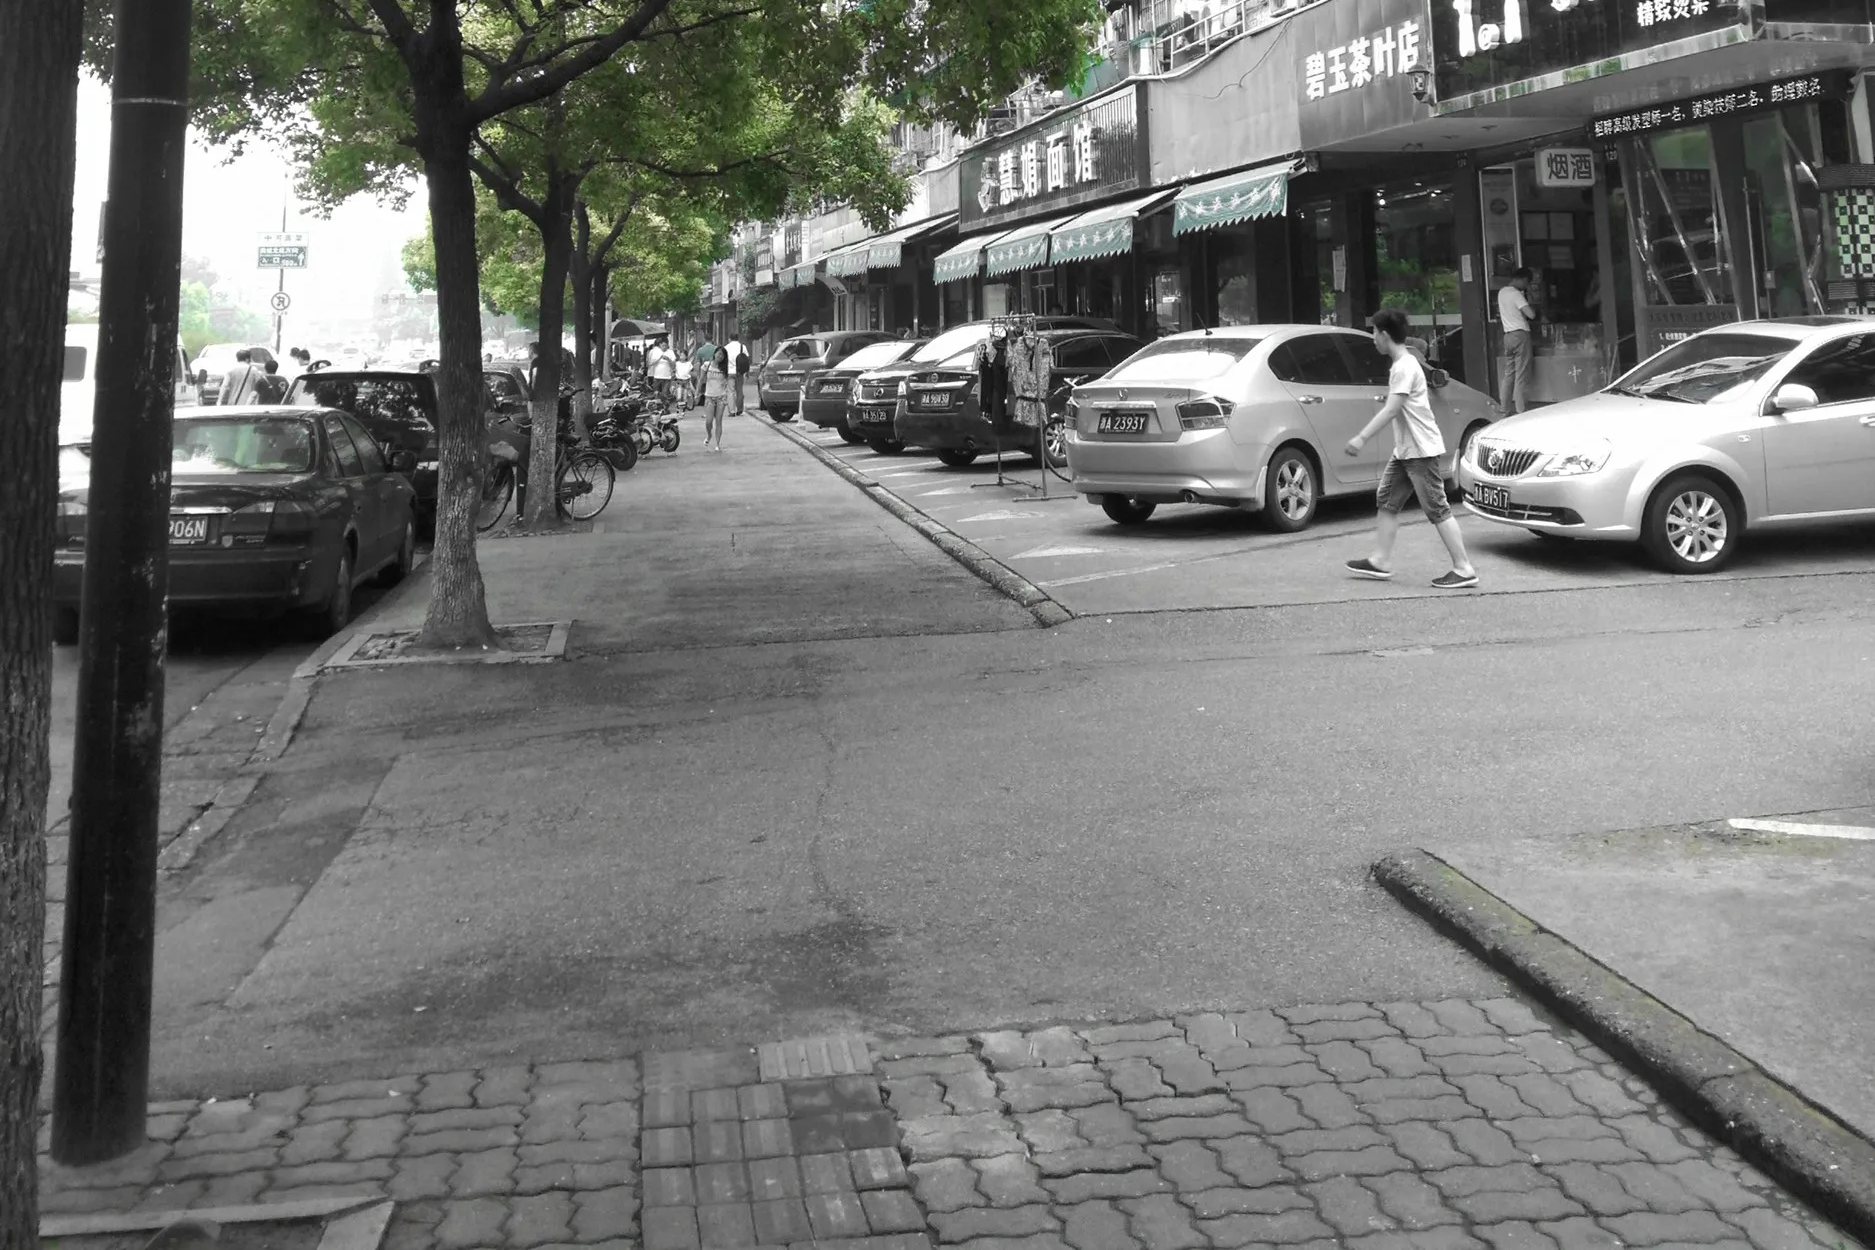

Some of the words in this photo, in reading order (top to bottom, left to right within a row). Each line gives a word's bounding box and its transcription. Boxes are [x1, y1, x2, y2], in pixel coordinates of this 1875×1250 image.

[1305, 19, 1420, 100] 碧玉茶叶店
[998, 120, 1096, 206] 慧娟面馆
[1547, 153, 1593, 180] 烟酒
